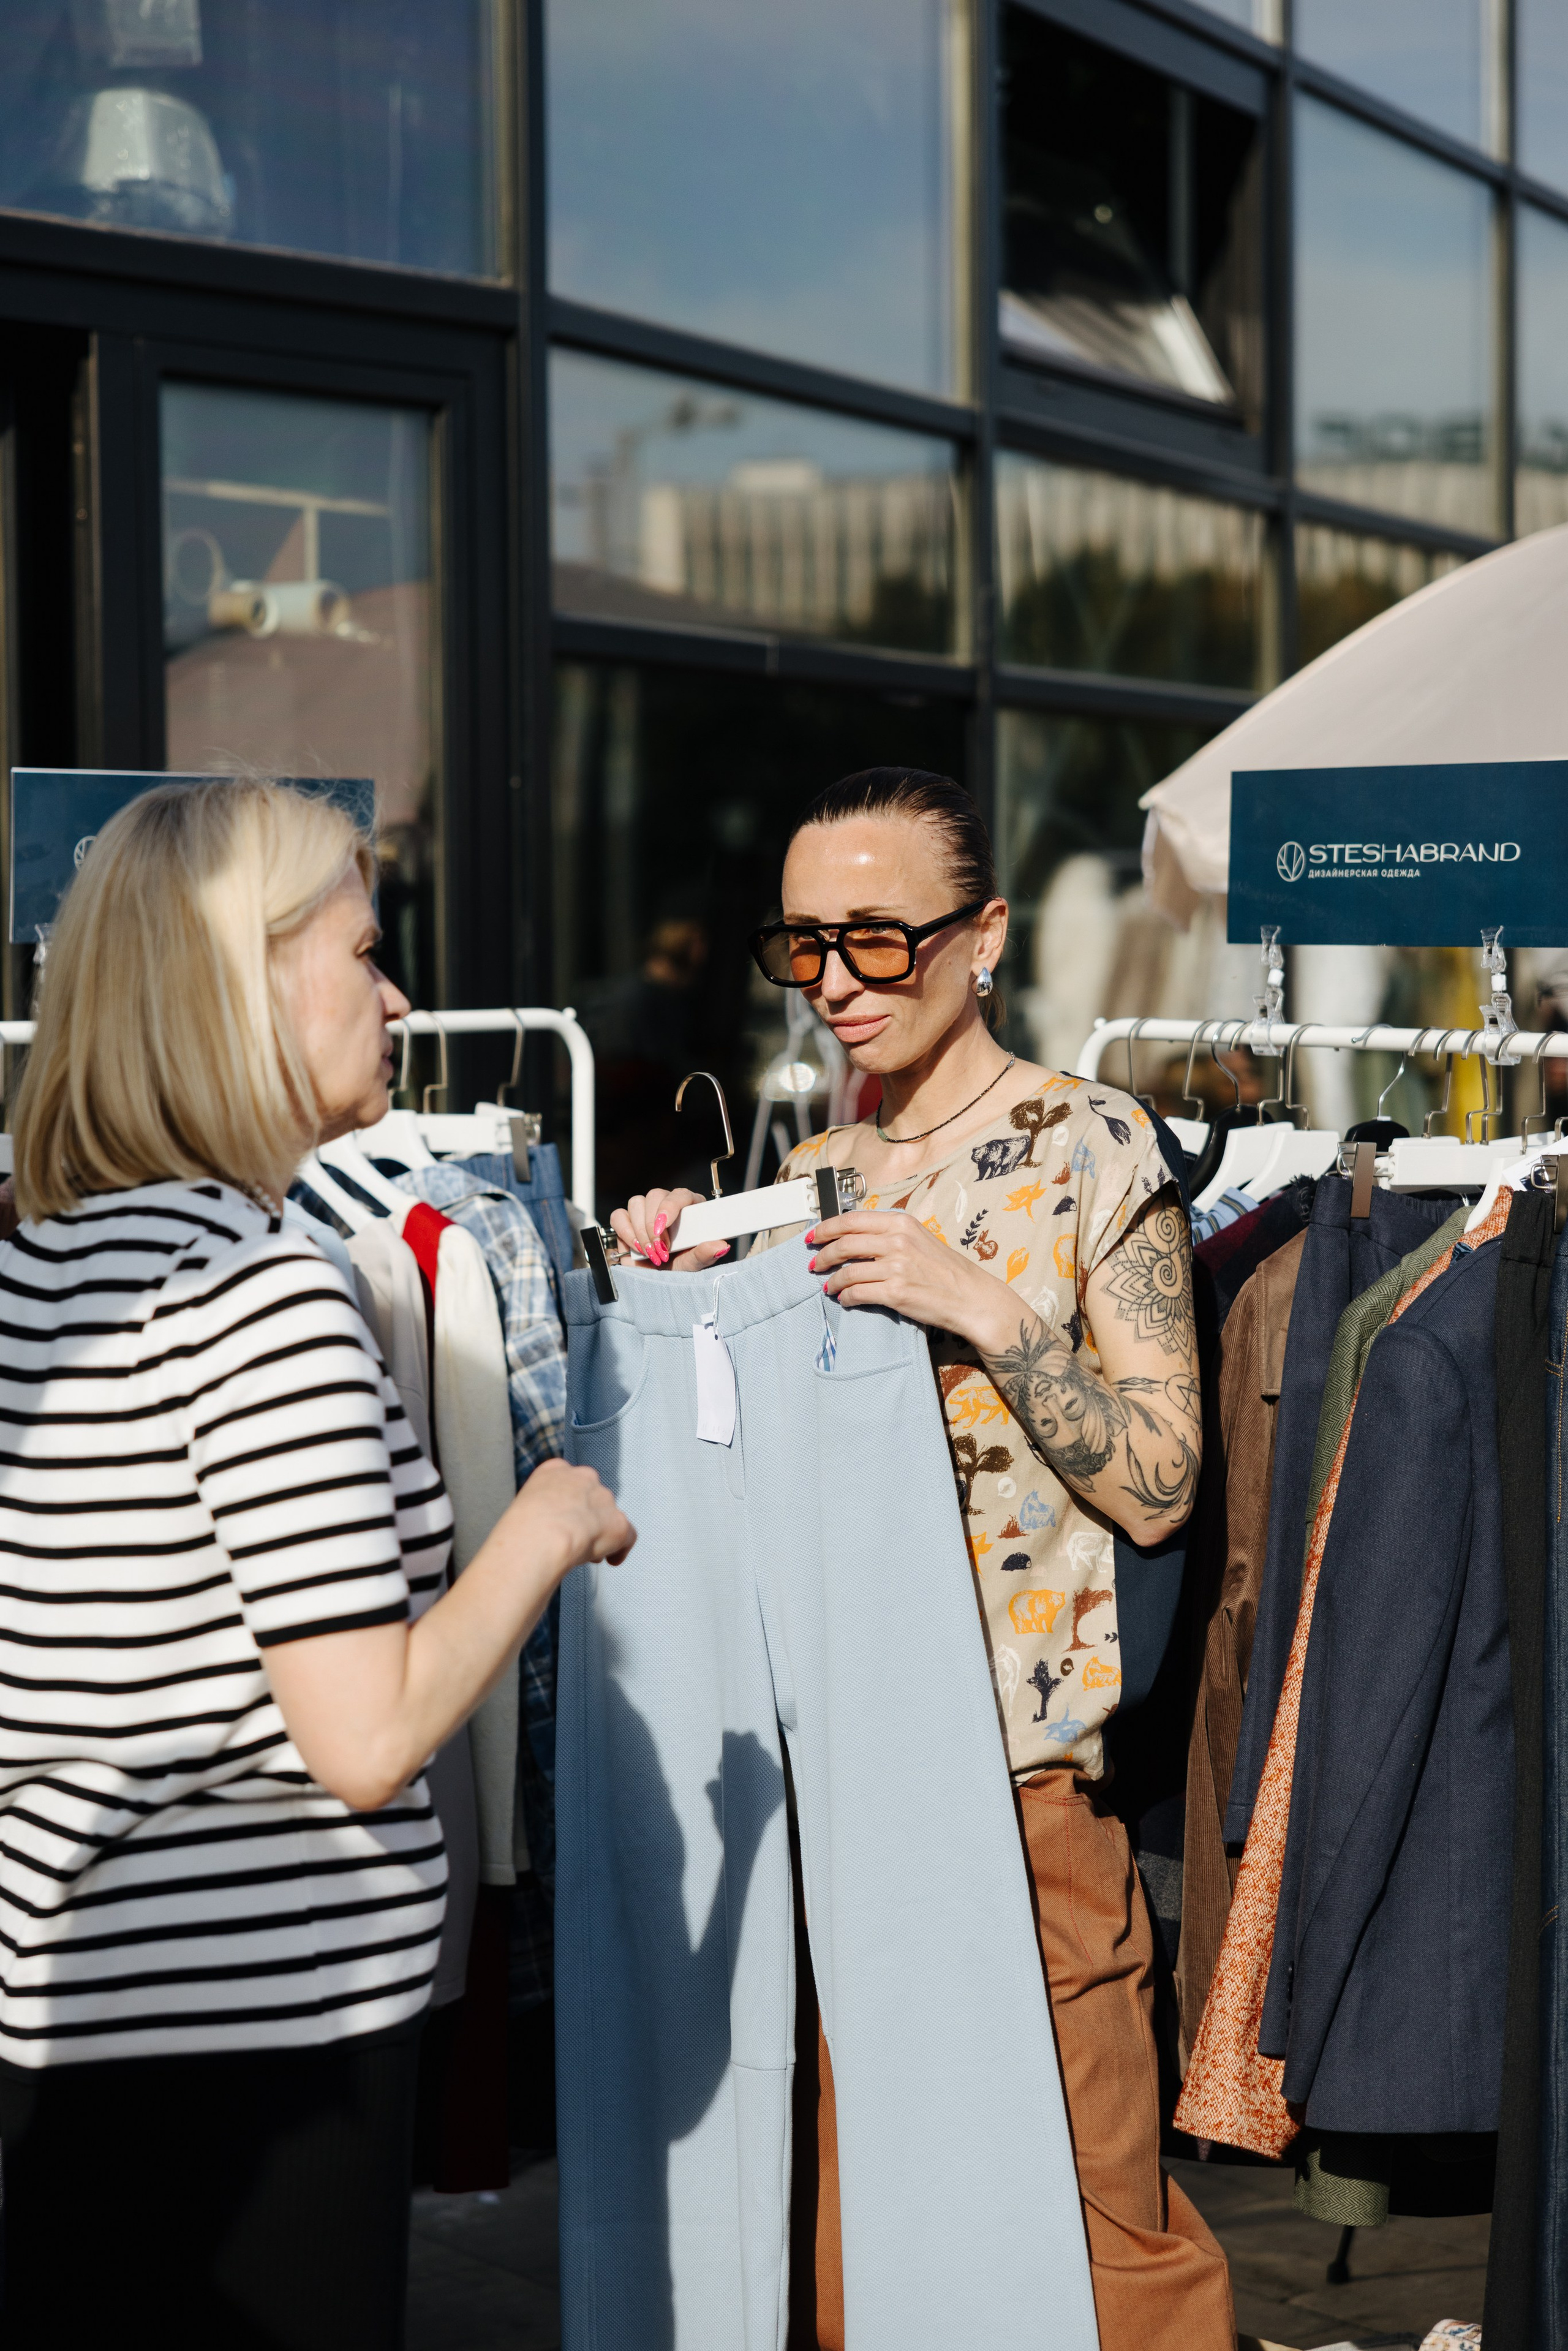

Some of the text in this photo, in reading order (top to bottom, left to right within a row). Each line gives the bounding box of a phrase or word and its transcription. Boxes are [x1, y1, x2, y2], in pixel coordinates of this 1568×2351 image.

[1308, 842, 1521, 864] STESHABRAND
[1308, 867, 1421, 879] ДИЗАЙНЕРСКАЯ ОДЕЖДА
